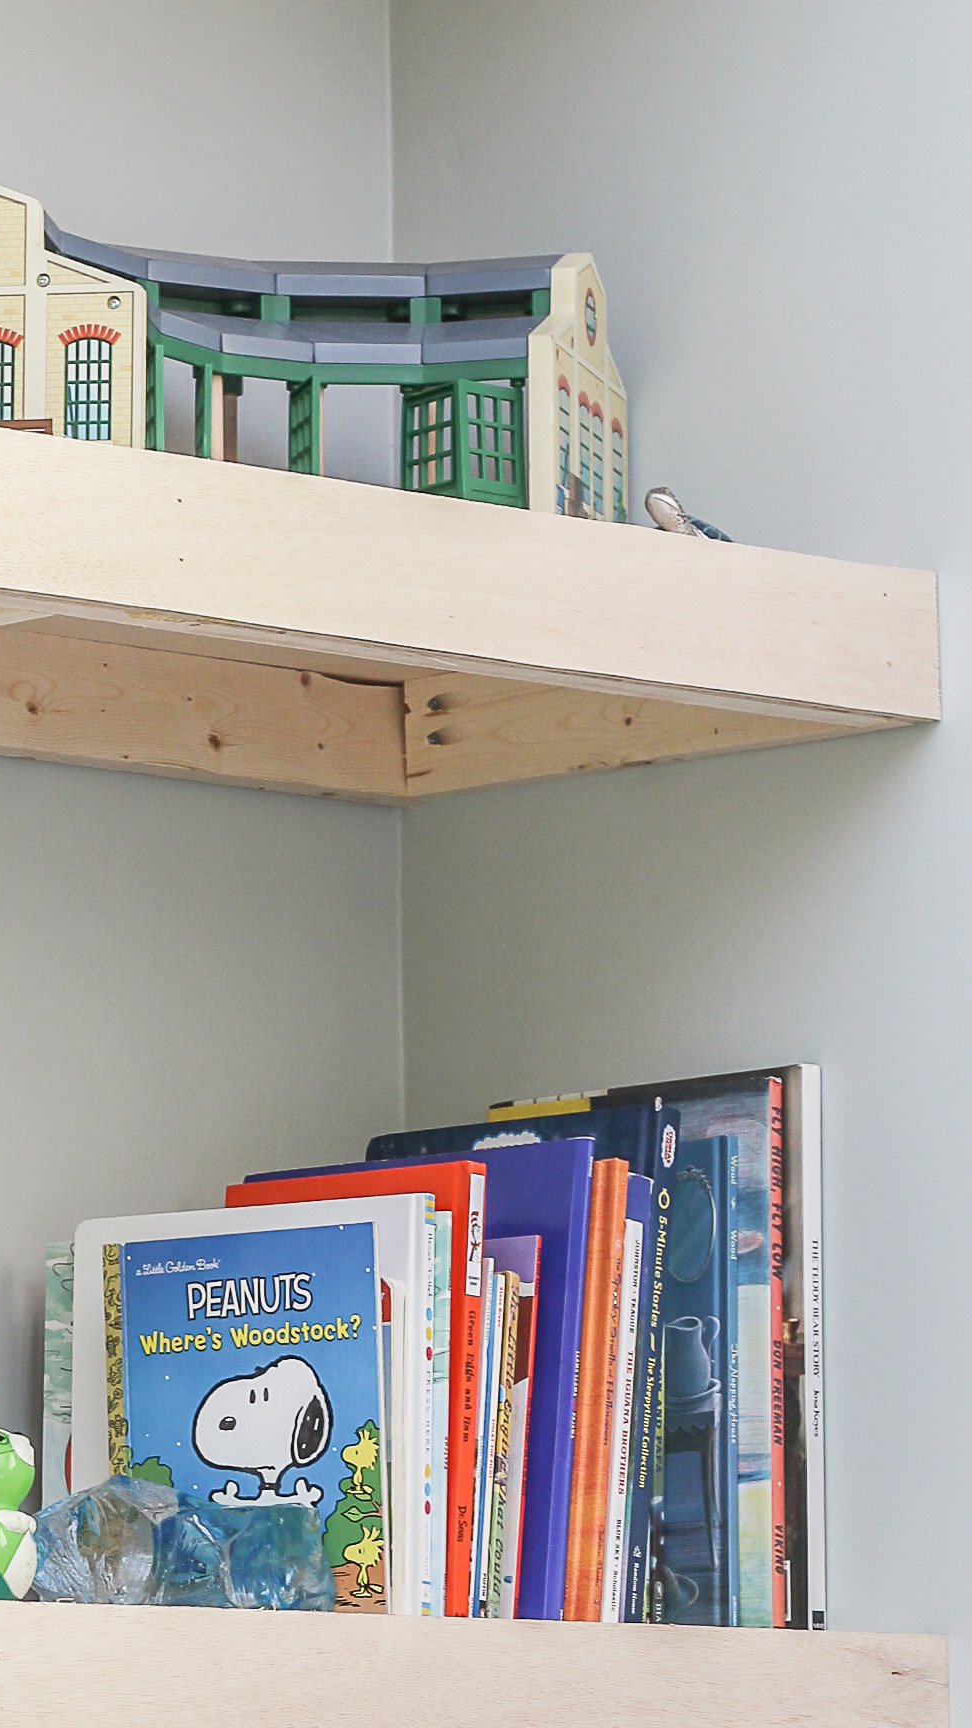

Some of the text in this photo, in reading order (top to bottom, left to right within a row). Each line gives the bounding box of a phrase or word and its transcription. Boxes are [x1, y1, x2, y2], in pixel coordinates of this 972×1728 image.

[771, 1106, 783, 1135] FLY
[730, 1155, 739, 1261] Wood Wood
[771, 1203, 783, 1232] FLY
[142, 1264, 166, 1276] Little
[165, 1260, 197, 1274] Golden
[195, 1258, 220, 1271] Book
[628, 1239, 641, 1334] JOHNSTON TEAGUE
[650, 1215, 668, 1328] 5-Minute Stories
[771, 1243, 783, 1281] LOW
[187, 1272, 314, 1321] PEANUTS
[509, 1285, 520, 1322] The
[811, 1239, 821, 1378] THE TEDDY BEAR STORY
[139, 1314, 362, 1356] Where's Woodstock?
[505, 1325, 517, 1391] Little
[463, 1310, 476, 1442] Green Eggs and Ham
[772, 1339, 784, 1446] DON FREEMAN
[617, 1350, 635, 1496] THE IGUANA BROTHERS
[638, 1357, 656, 1489] The Sleepytime Collection
[456, 1505, 468, 1543] Dr. Seuss
[774, 1524, 785, 1576] VIKING
[492, 1538, 504, 1598] Could
[654, 1602, 663, 1623] DIA
